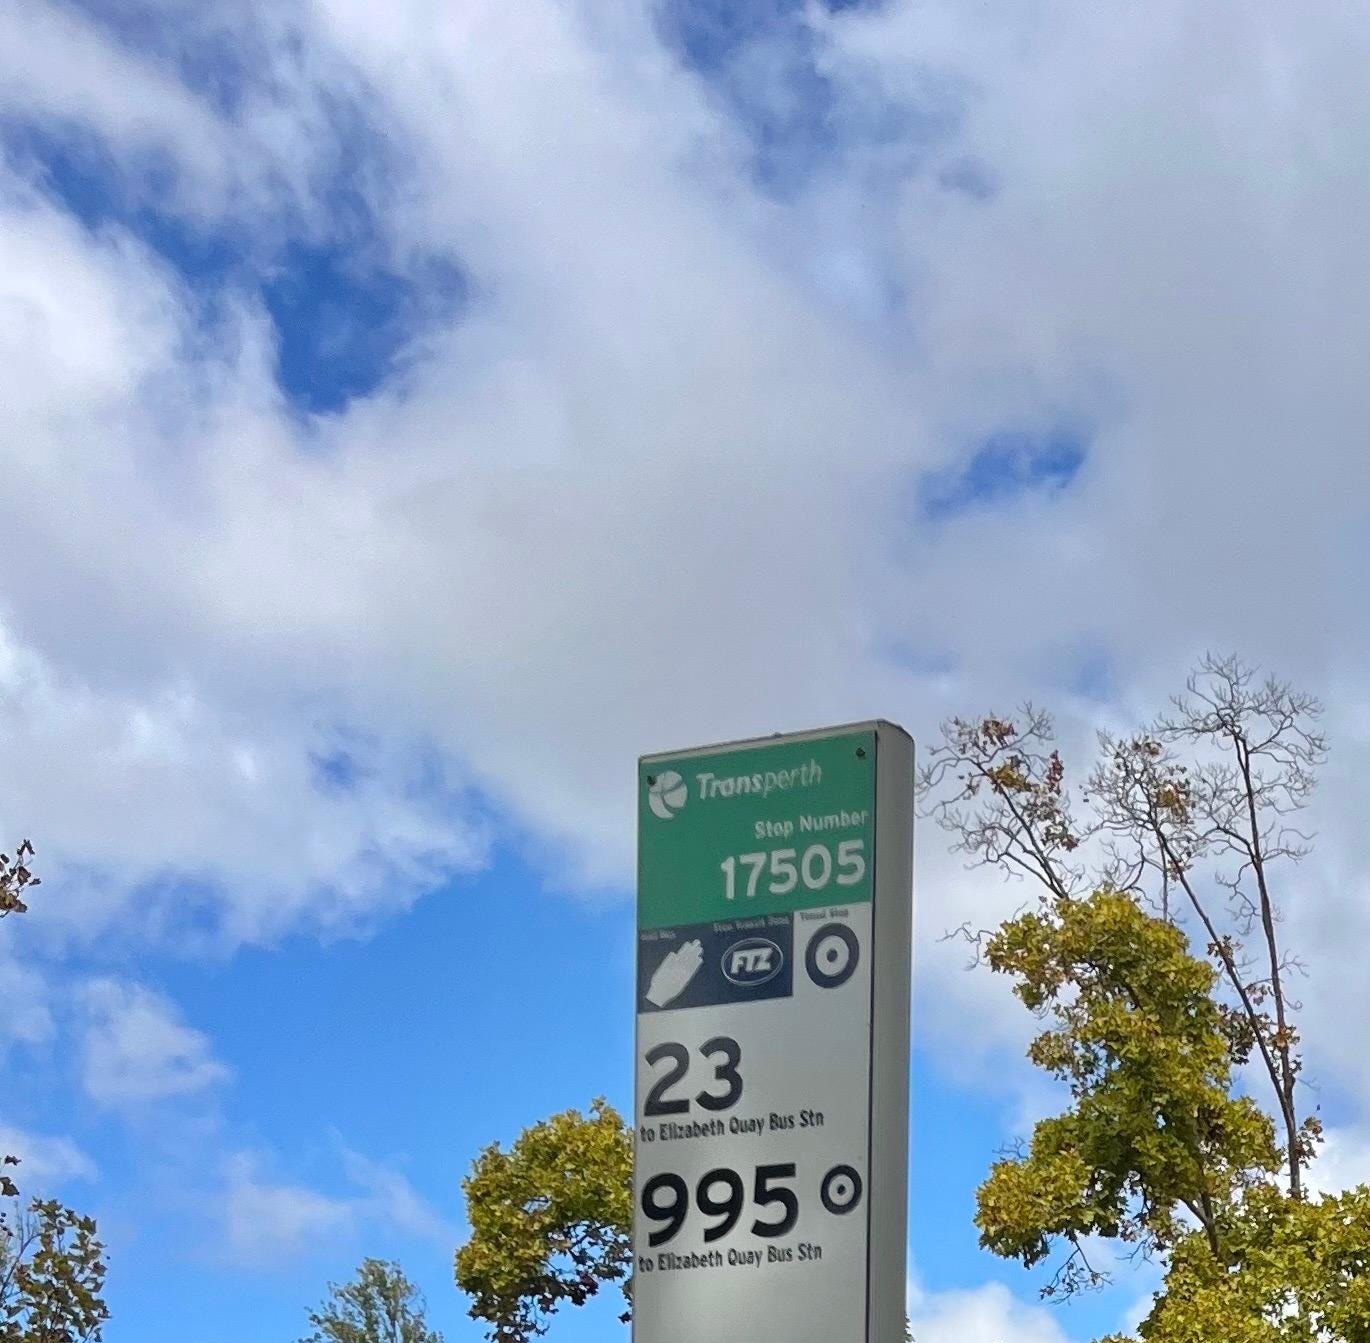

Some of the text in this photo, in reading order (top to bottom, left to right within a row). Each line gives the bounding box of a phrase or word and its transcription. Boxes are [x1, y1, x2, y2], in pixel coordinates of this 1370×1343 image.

[696, 760, 822, 799] Transperth
[755, 810, 869, 839] Stop Number
[720, 839, 866, 899] 17505
[731, 947, 774, 975] FTZ
[644, 1036, 743, 1116] 23
[640, 1109, 824, 1142] to Elizabeth Quay Bus Stn
[642, 1162, 799, 1247] 995
[638, 1242, 822, 1273] to Elizabeth Quay Bus Stn
